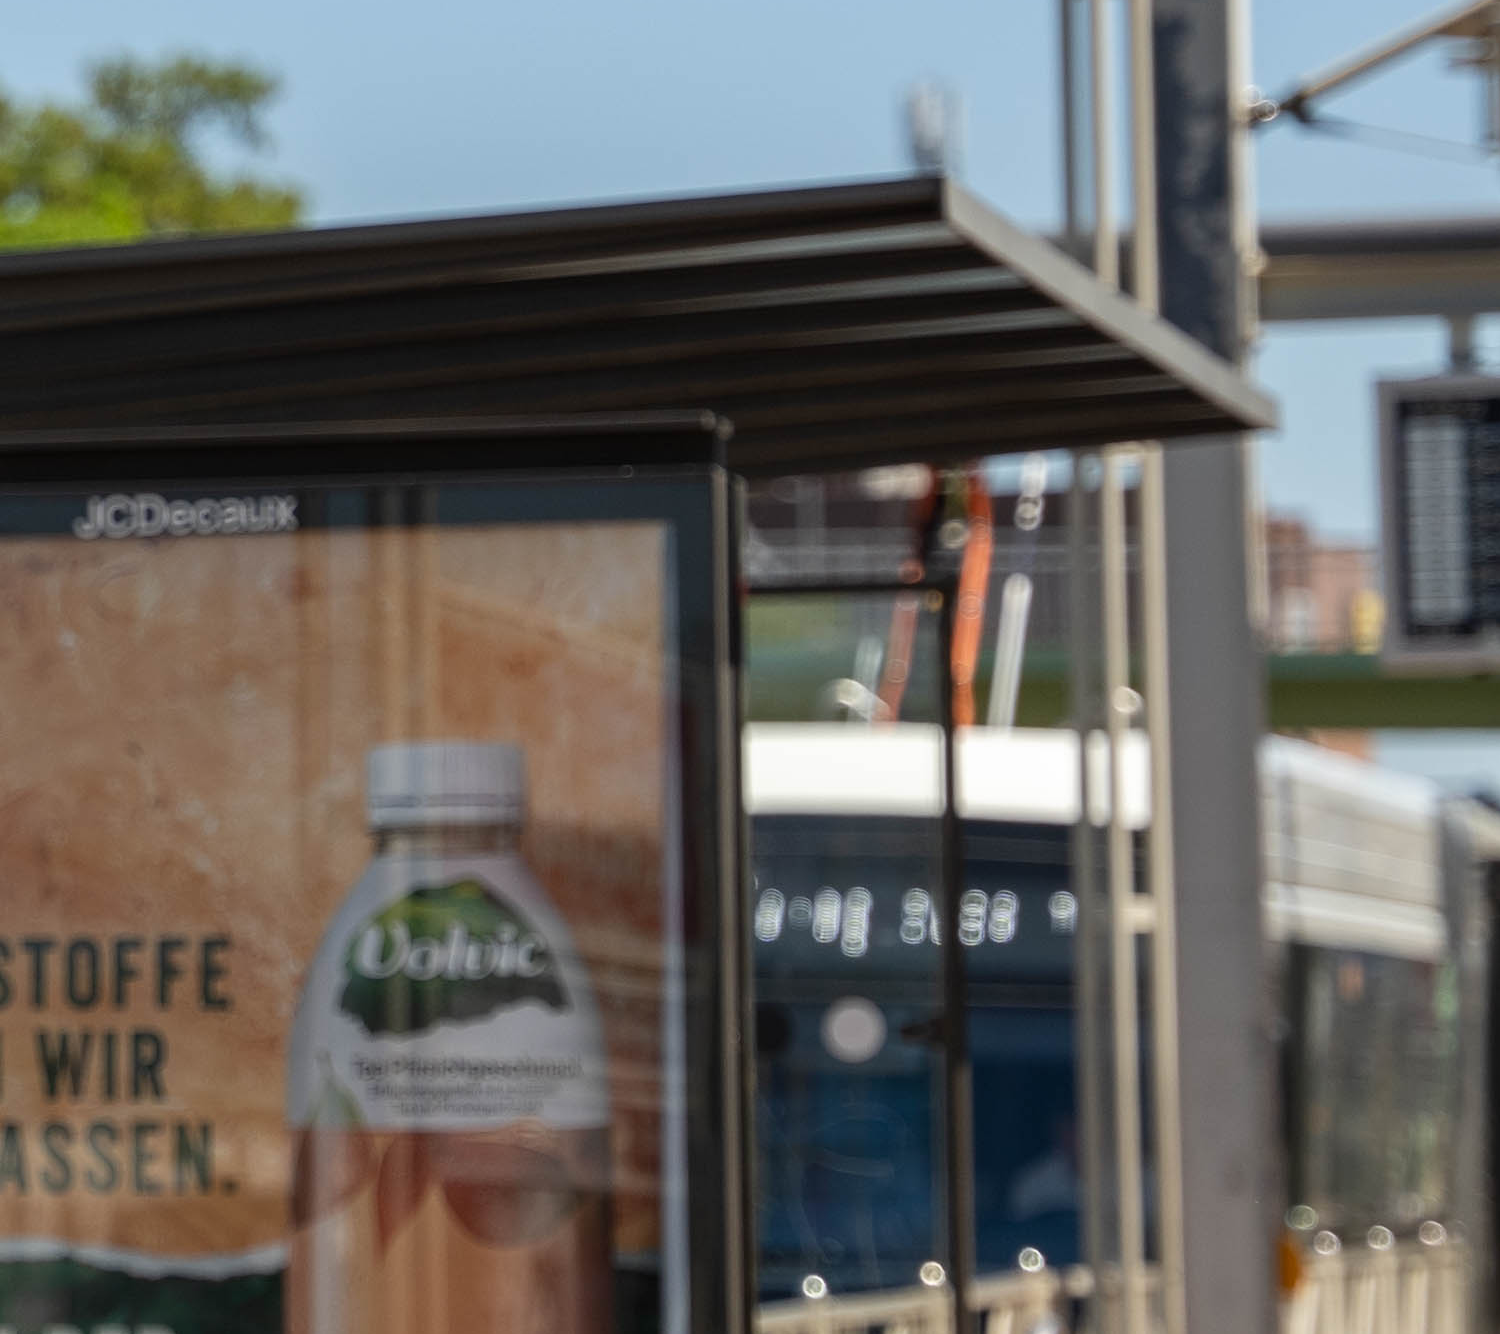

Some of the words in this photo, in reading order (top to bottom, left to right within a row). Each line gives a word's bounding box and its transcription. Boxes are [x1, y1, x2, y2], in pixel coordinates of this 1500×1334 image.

[73, 493, 299, 540] JCDecaux
[356, 920, 550, 981] Volvic
[38, 1029, 167, 1102] WIR
